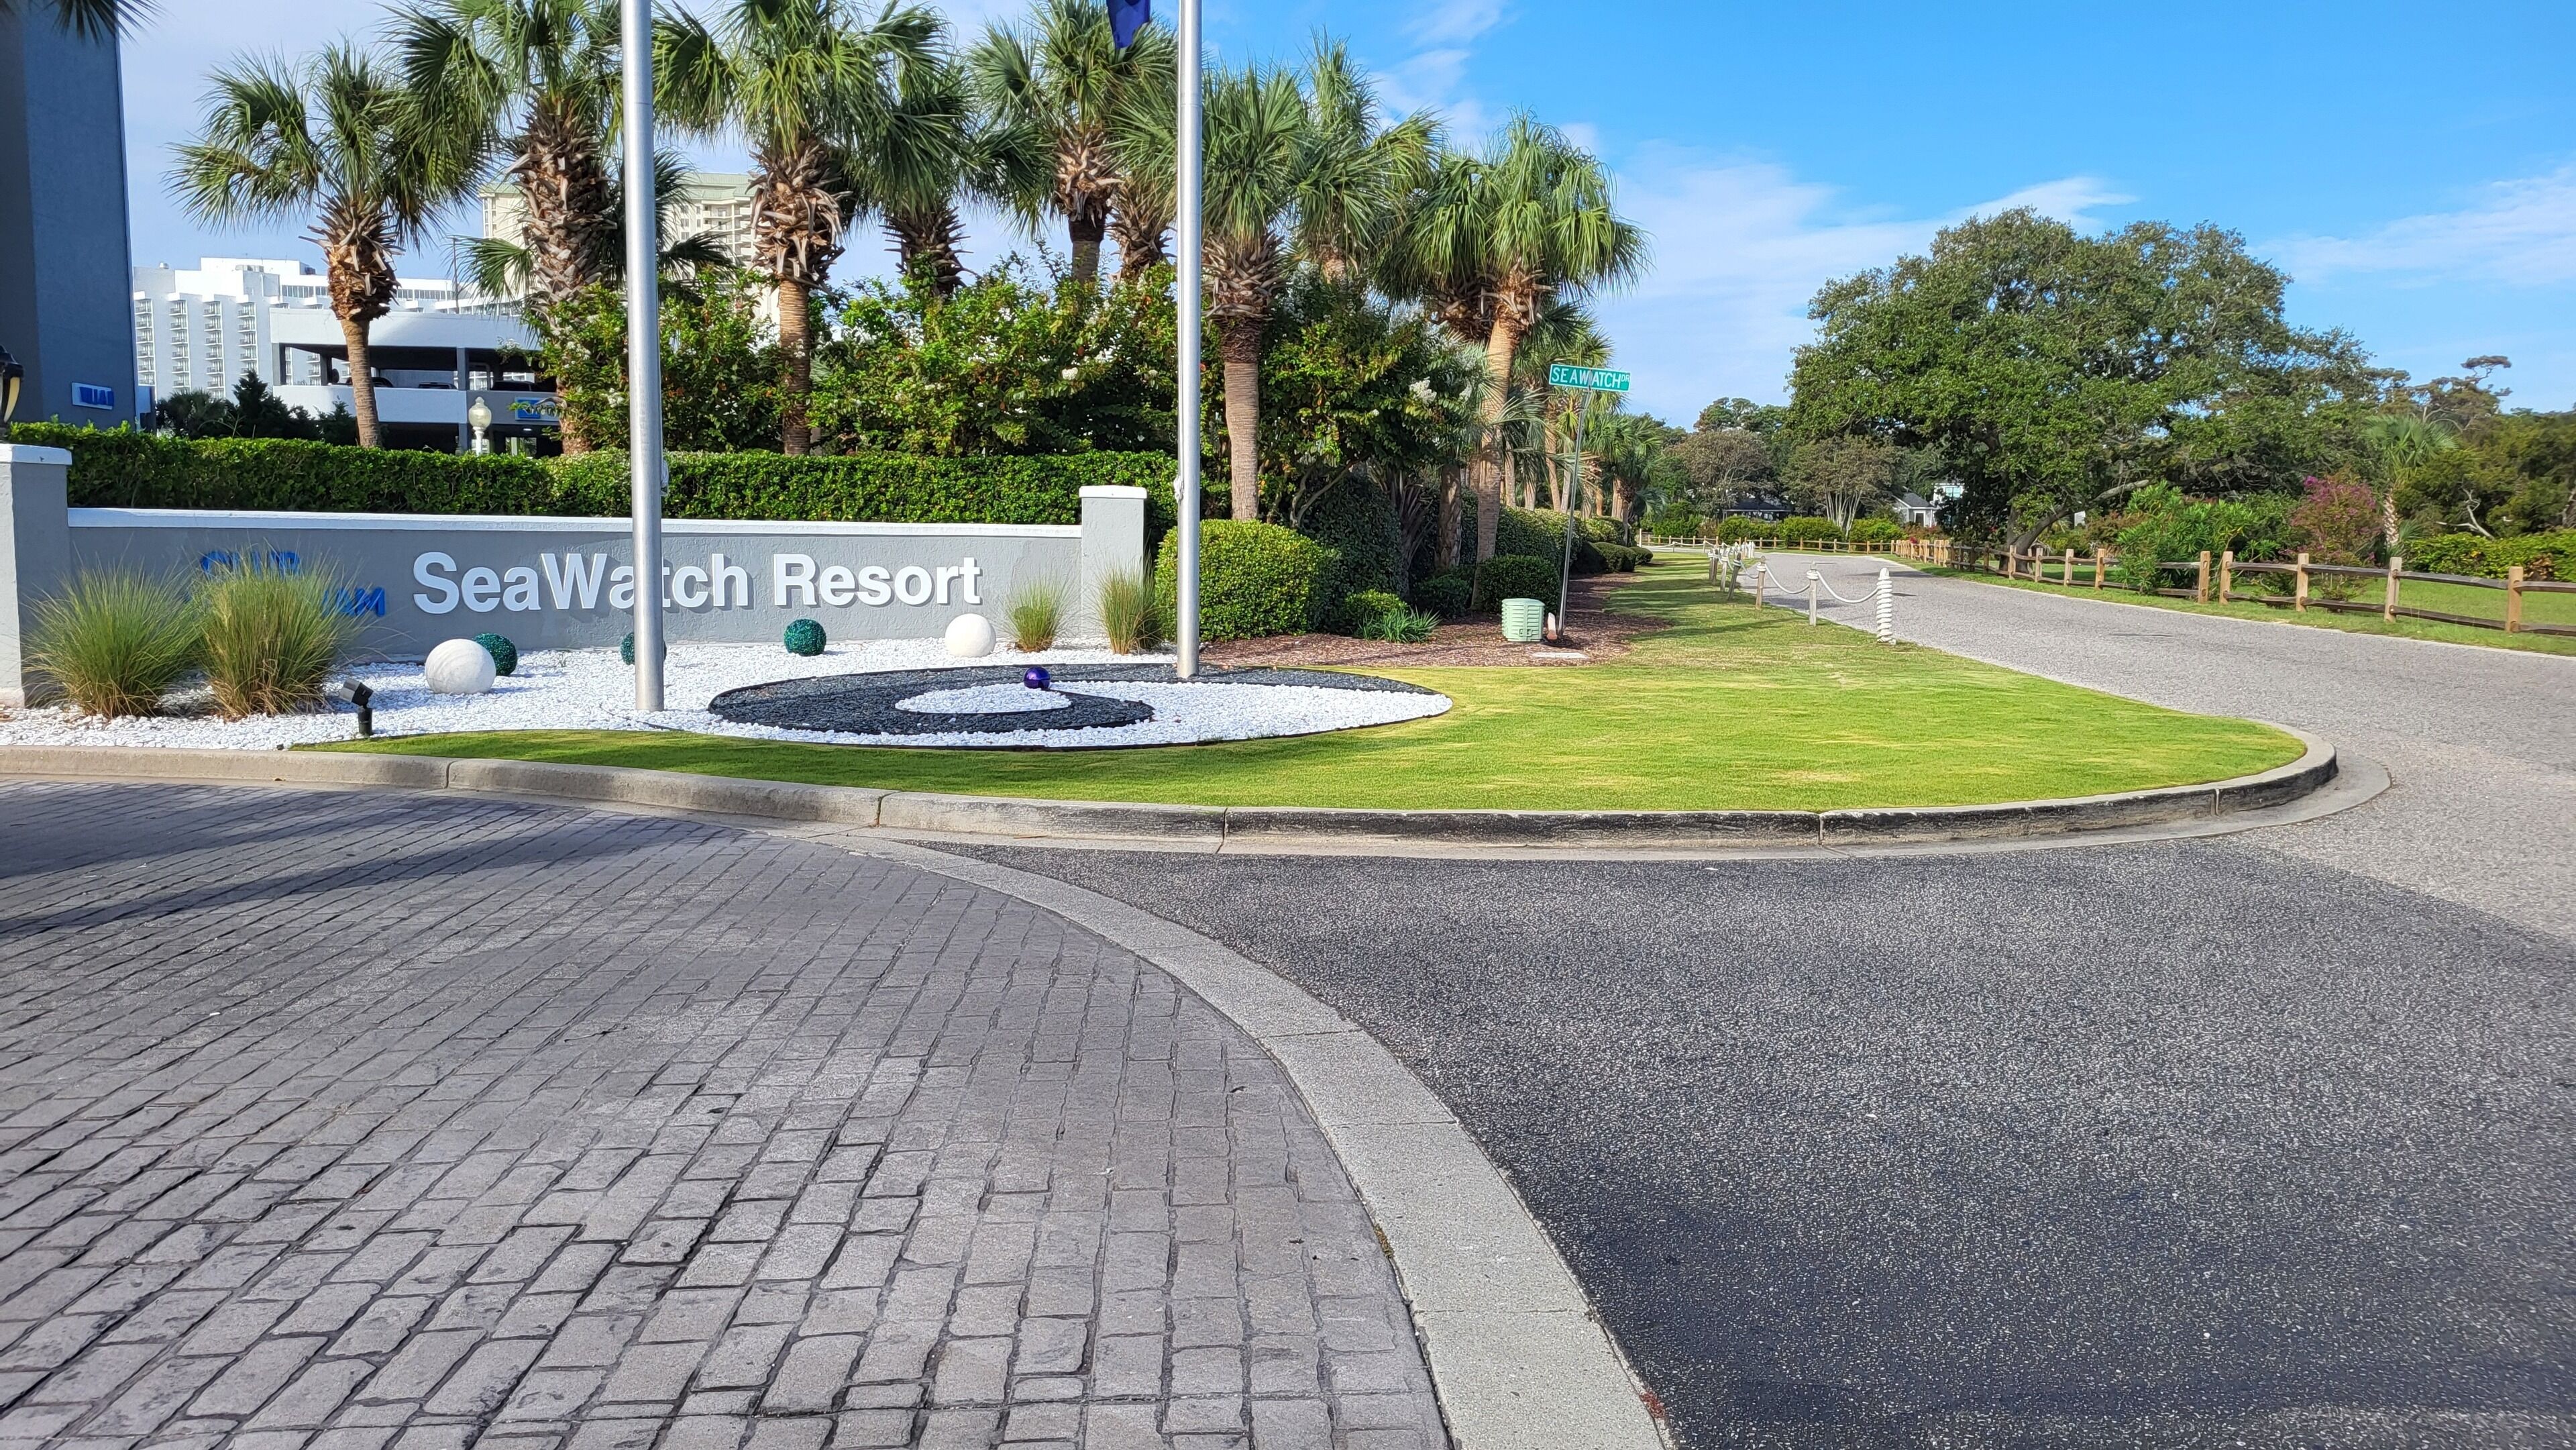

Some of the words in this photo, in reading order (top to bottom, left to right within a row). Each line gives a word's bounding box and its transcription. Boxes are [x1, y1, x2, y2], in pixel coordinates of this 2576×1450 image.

[1551, 367, 1621, 389] SEAWATCH
[1621, 374, 1630, 382] DR
[773, 554, 981, 606] Resort
